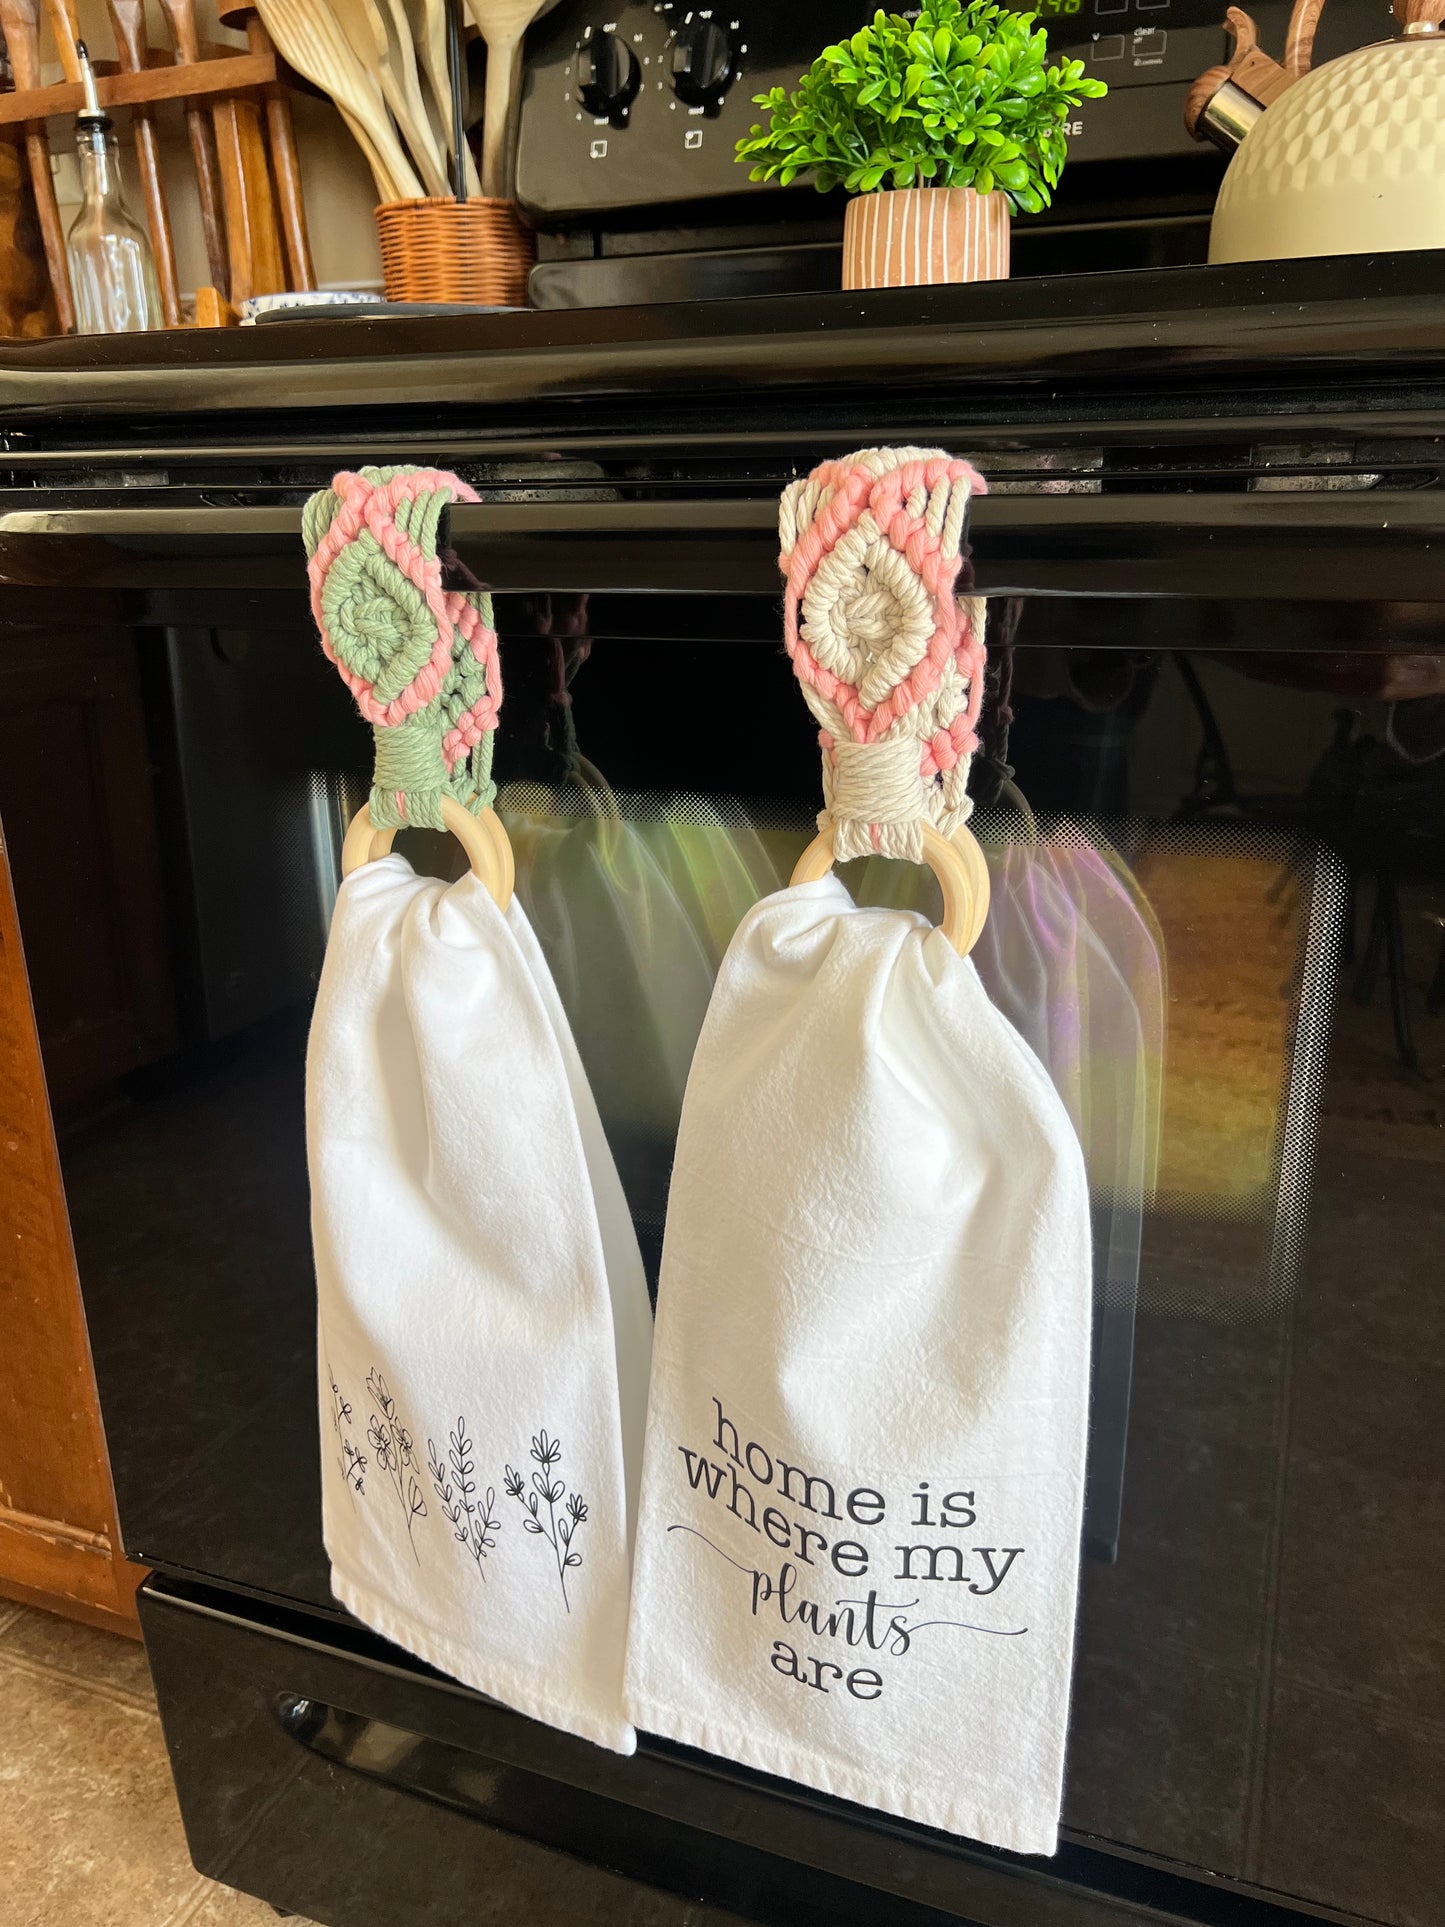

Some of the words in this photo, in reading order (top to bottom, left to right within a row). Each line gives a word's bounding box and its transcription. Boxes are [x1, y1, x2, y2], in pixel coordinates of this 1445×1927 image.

[712, 1396, 886, 1526] home
[910, 1481, 977, 1528] is
[678, 1445, 869, 1577] where
[893, 1543, 1025, 1595] my
[751, 1562, 920, 1656] plants
[770, 1640, 884, 1700] are
